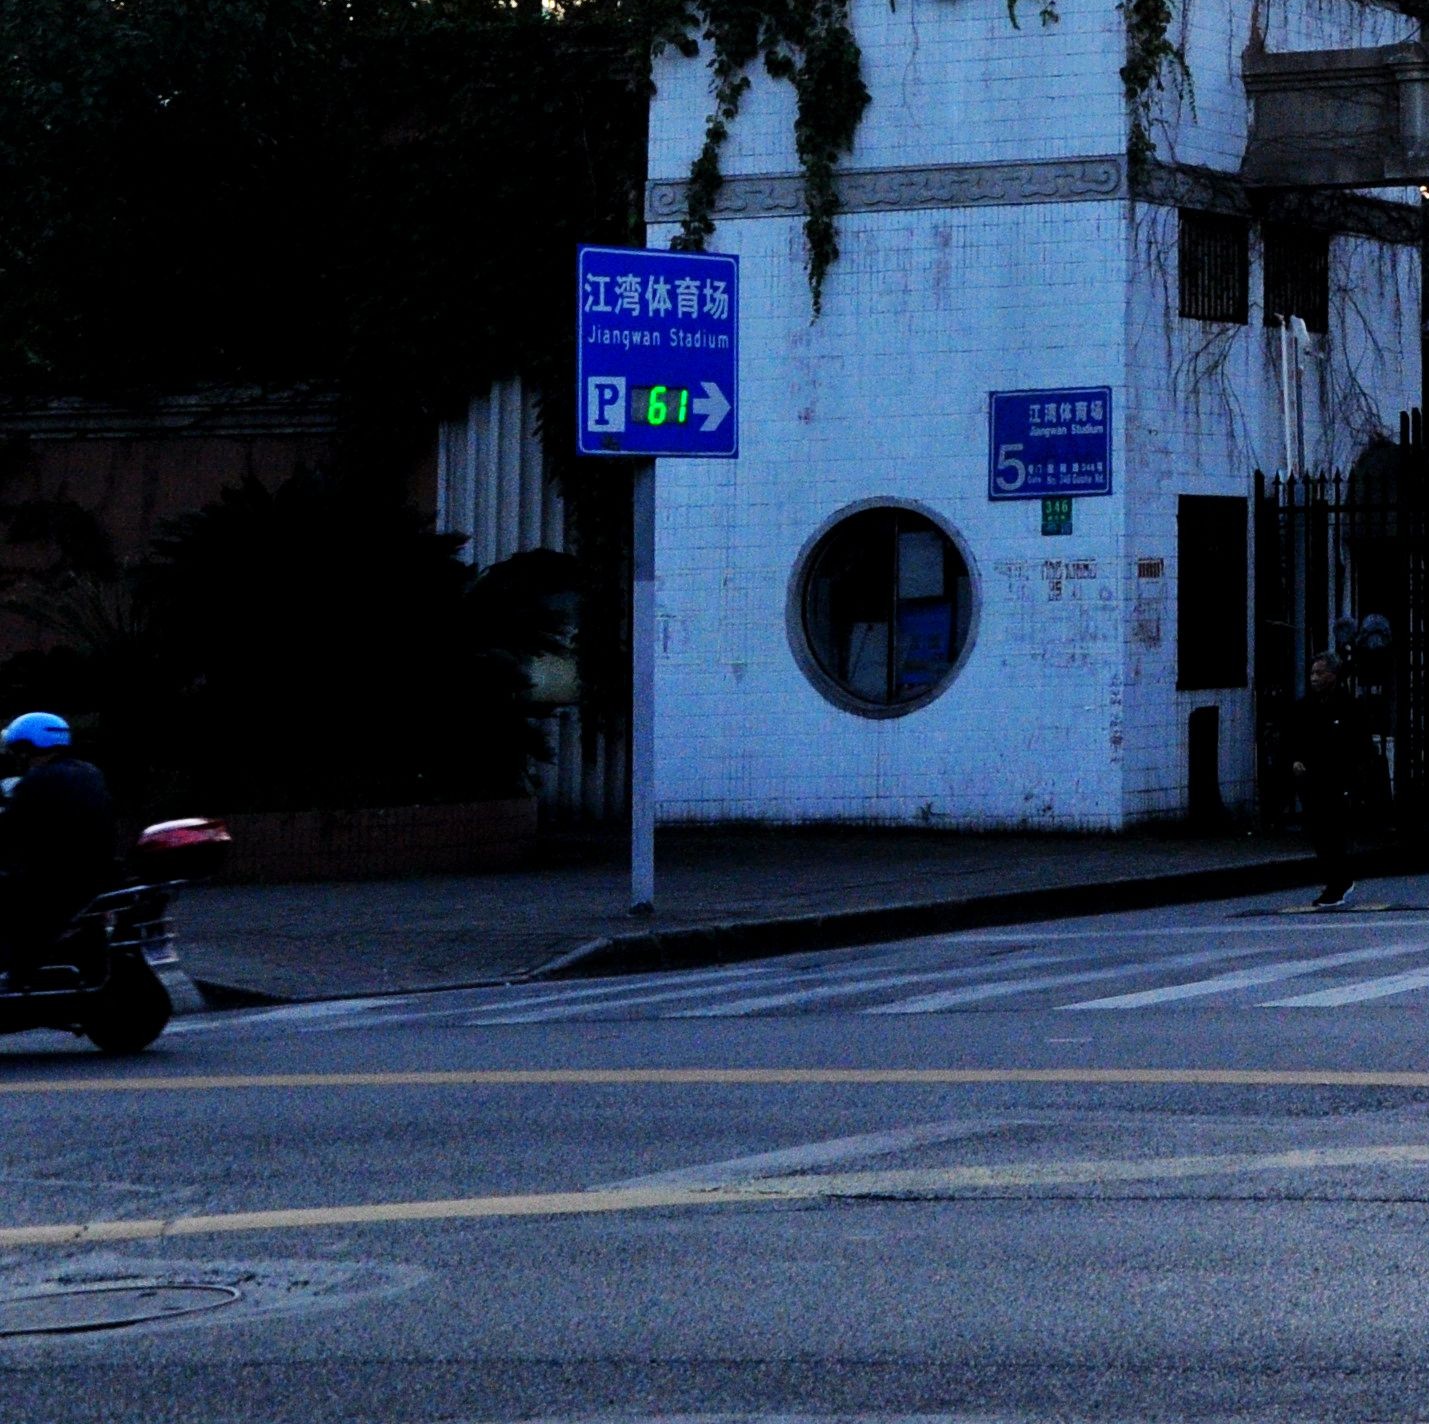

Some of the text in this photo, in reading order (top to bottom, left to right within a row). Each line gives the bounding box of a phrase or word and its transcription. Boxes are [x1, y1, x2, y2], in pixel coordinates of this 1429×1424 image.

[584, 273, 729, 320] 江湾体育场
[588, 325, 729, 350] Jiangwan Stadium
[594, 383, 620, 426] P
[647, 385, 688, 425] 61
[1028, 400, 1104, 424] 江湾体育场
[996, 443, 1026, 491] 5
